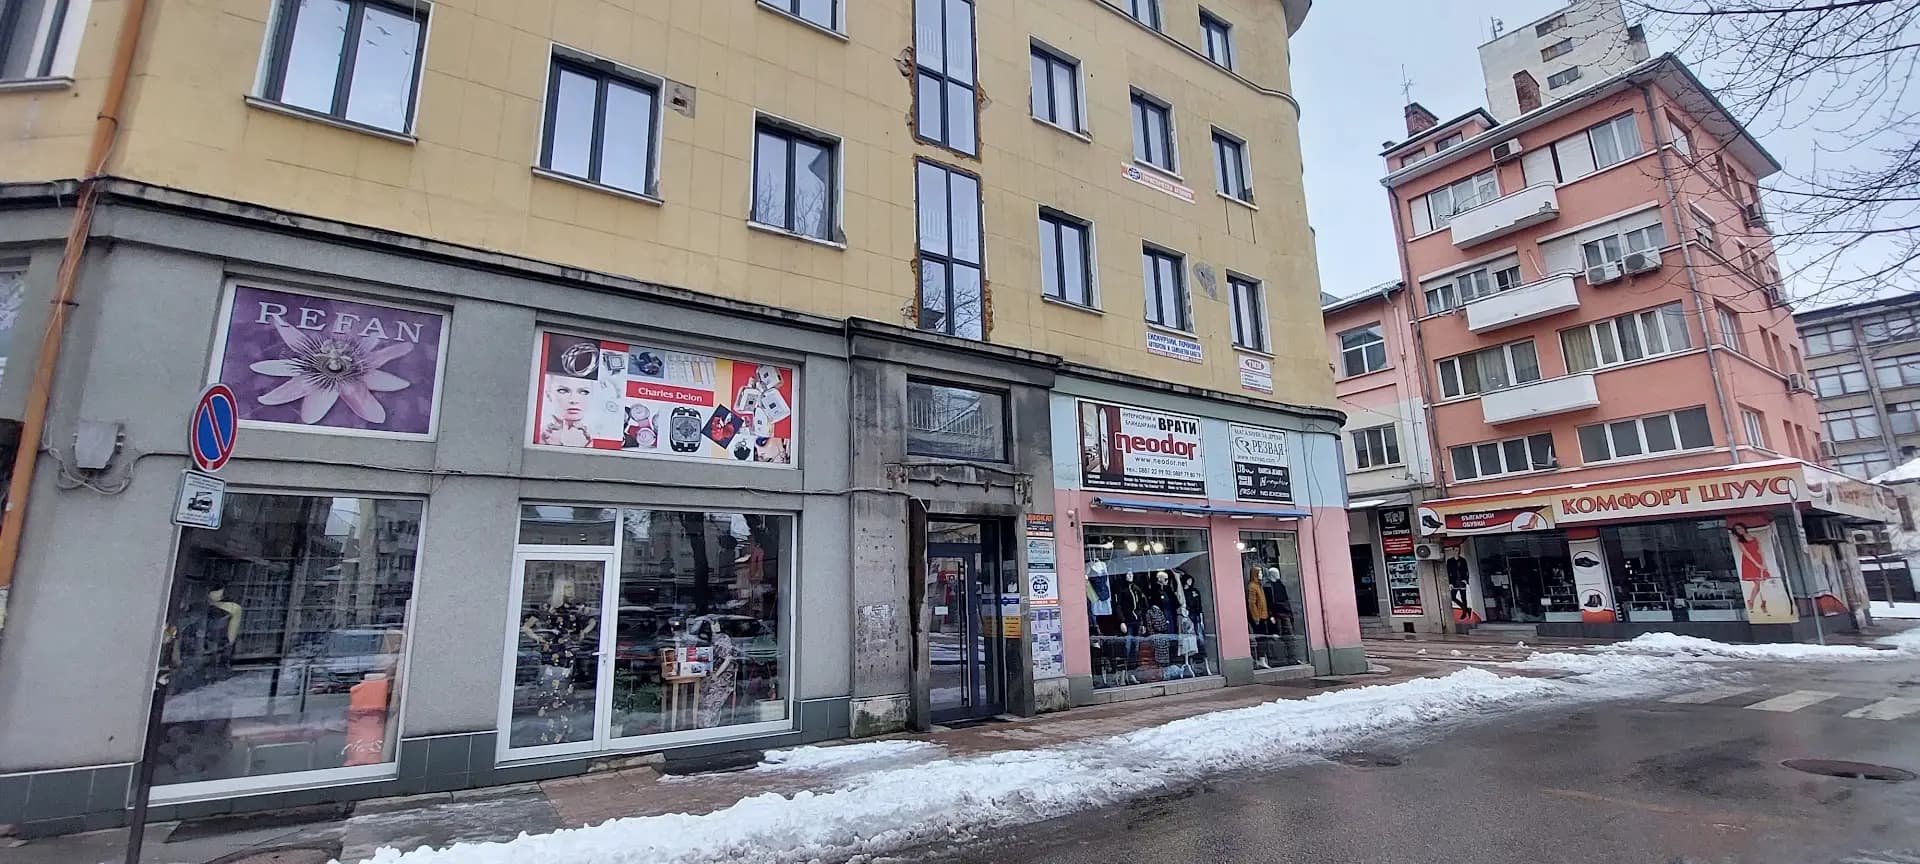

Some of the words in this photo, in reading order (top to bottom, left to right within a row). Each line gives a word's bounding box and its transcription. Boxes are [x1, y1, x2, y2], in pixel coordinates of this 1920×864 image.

[255, 302, 424, 343] REFAN
[638, 387, 674, 400] Charles
[676, 392, 703, 403] Delon
[1158, 417, 1197, 435] ВРАТИ
[1115, 432, 1197, 461] neodor
[1252, 439, 1284, 460] РЕЗВАЯ
[1135, 456, 1188, 467] www.neodor.net
[1561, 486, 1690, 515] КОМФОРТ
[1700, 476, 1790, 502] ШУУС
[1461, 513, 1495, 522] БЪЛГАРСКИ
[1462, 520, 1486, 528] ОБУВКИ
